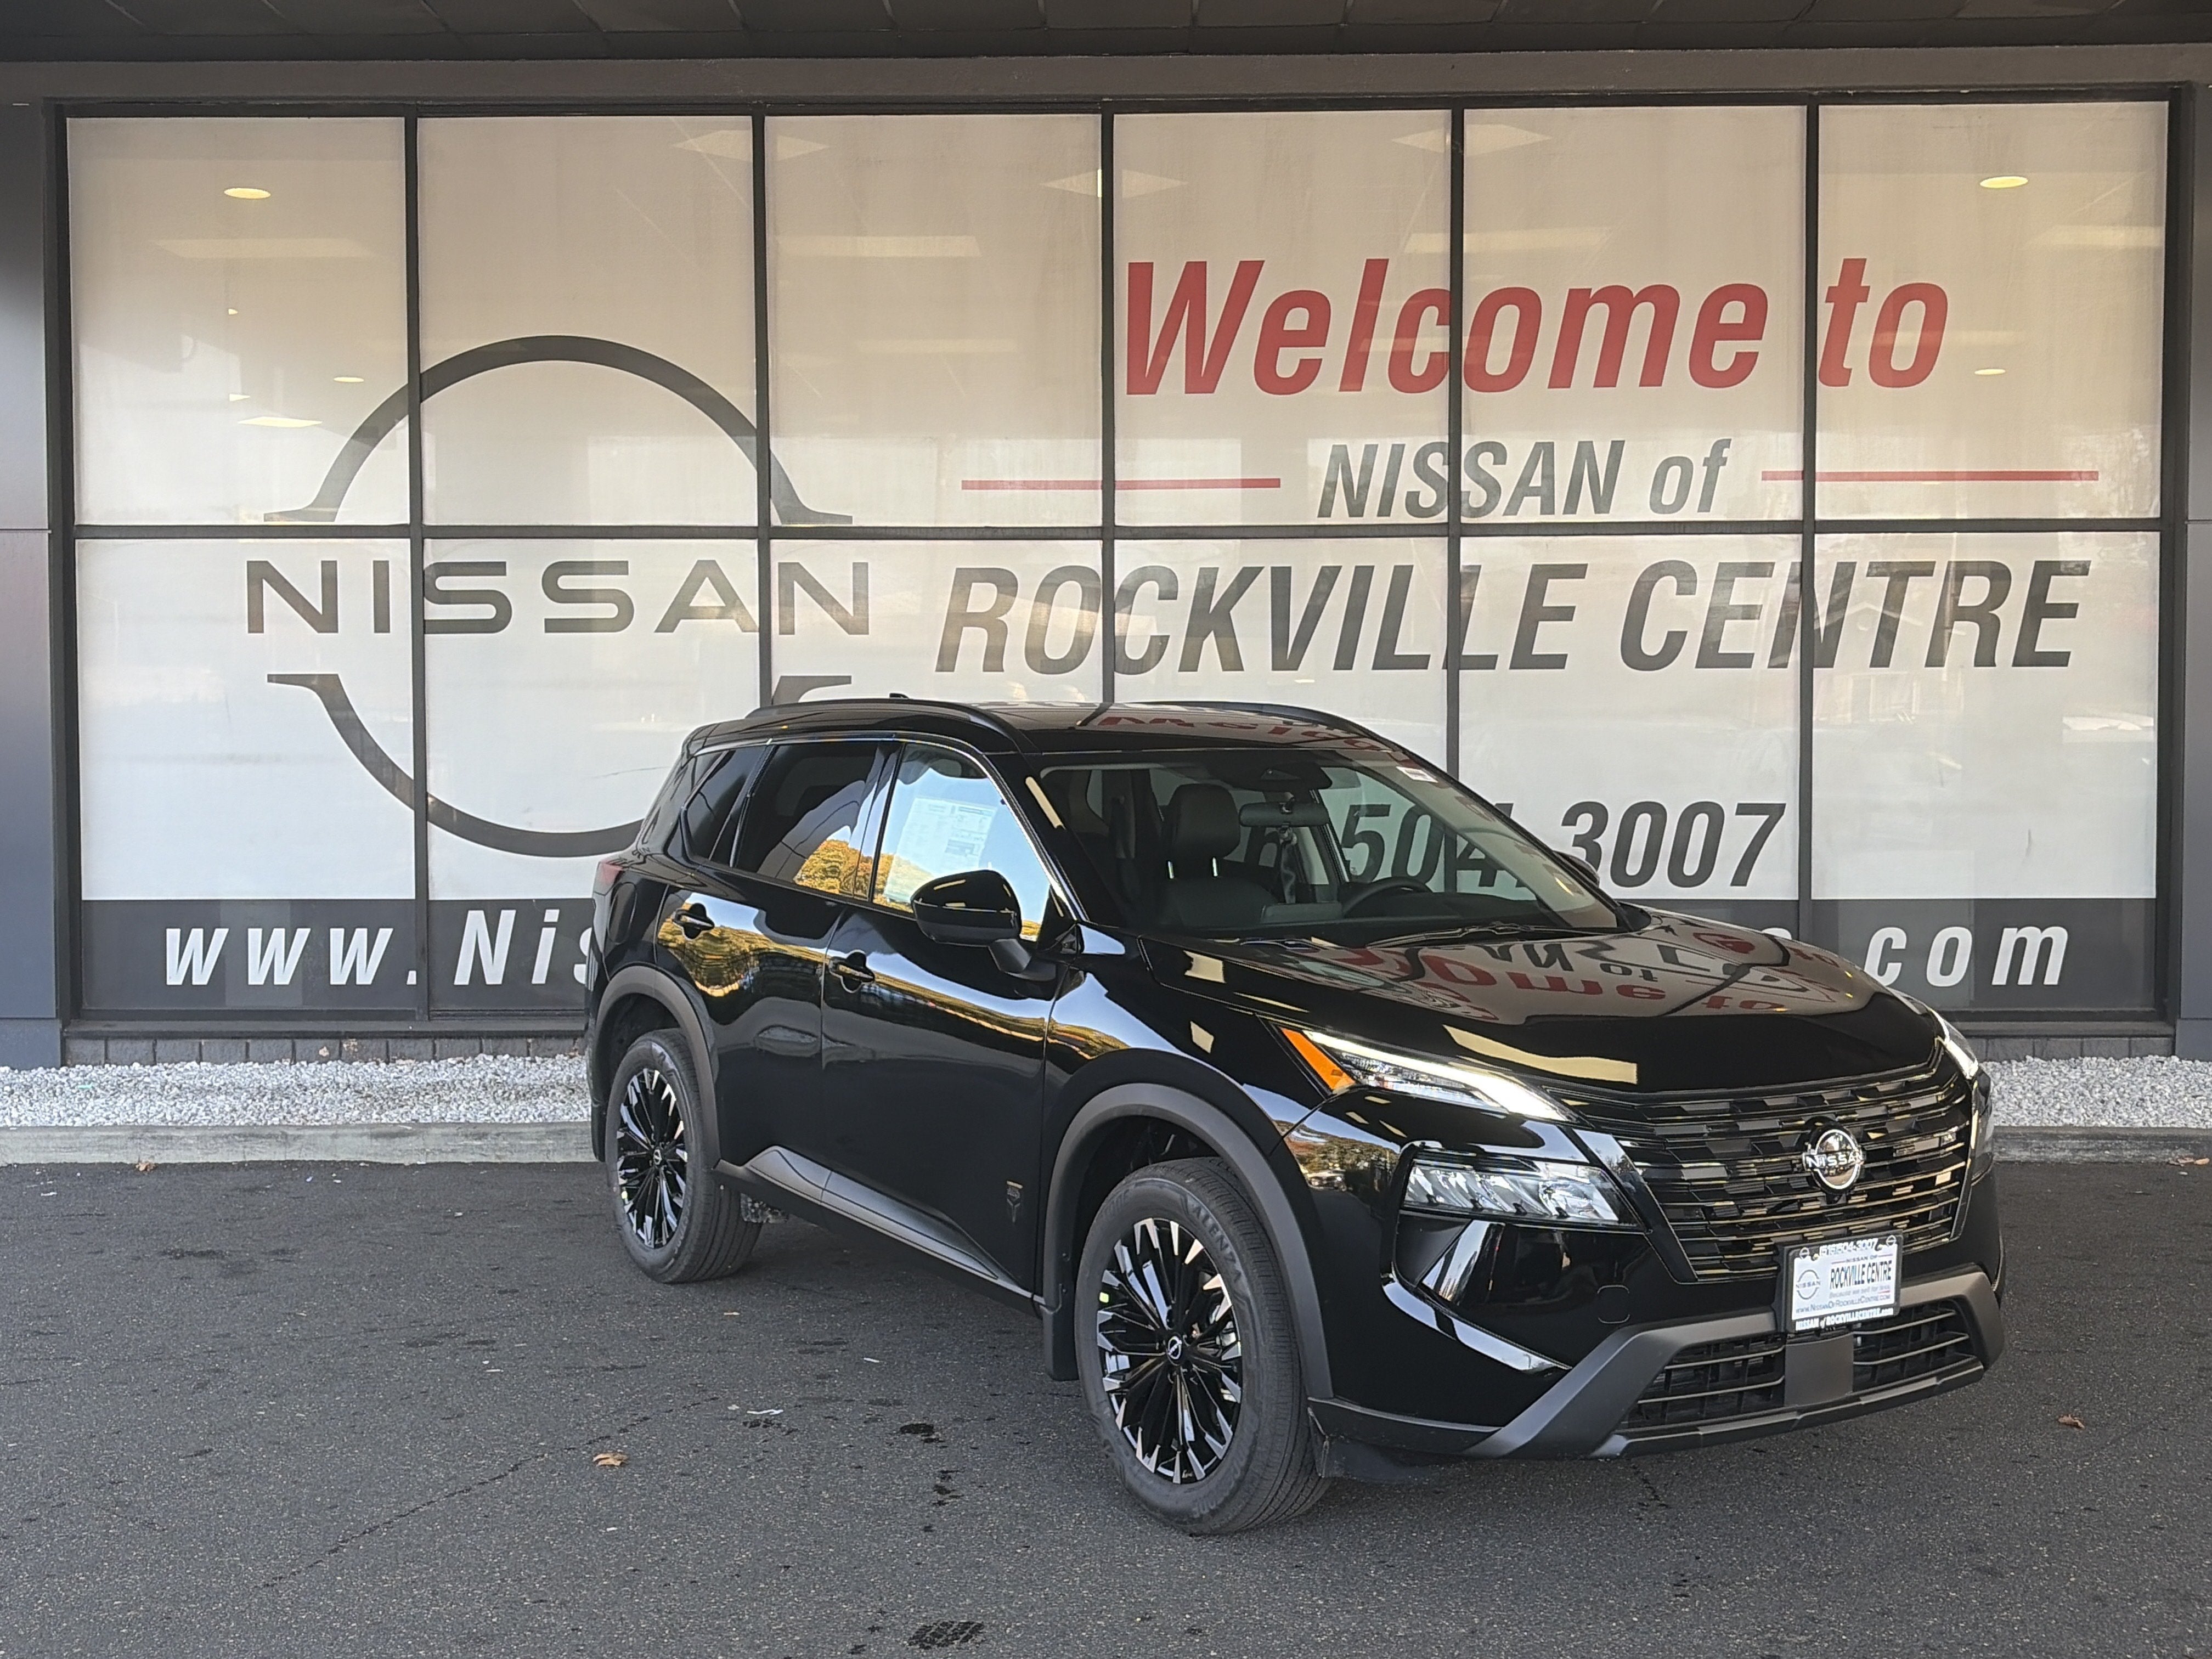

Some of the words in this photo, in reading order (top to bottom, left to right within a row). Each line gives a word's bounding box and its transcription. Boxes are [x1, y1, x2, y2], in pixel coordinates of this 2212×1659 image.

[1126, 258, 1768, 395] Welcome
[1818, 257, 1948, 388] to
[1317, 439, 1625, 518] NISSAN
[1649, 438, 1732, 514] of
[246, 559, 870, 636] NISSAN
[934, 563, 1589, 676] ROCKVILLE
[1618, 559, 2091, 672] CENTRE
[1805, 1151, 1864, 1167] NISSAN
[1796, 1280, 1821, 1289] NISSAN
[1830, 1263, 1866, 1290] ROCKVILLE
[1867, 1260, 1892, 1284] CENTRE
